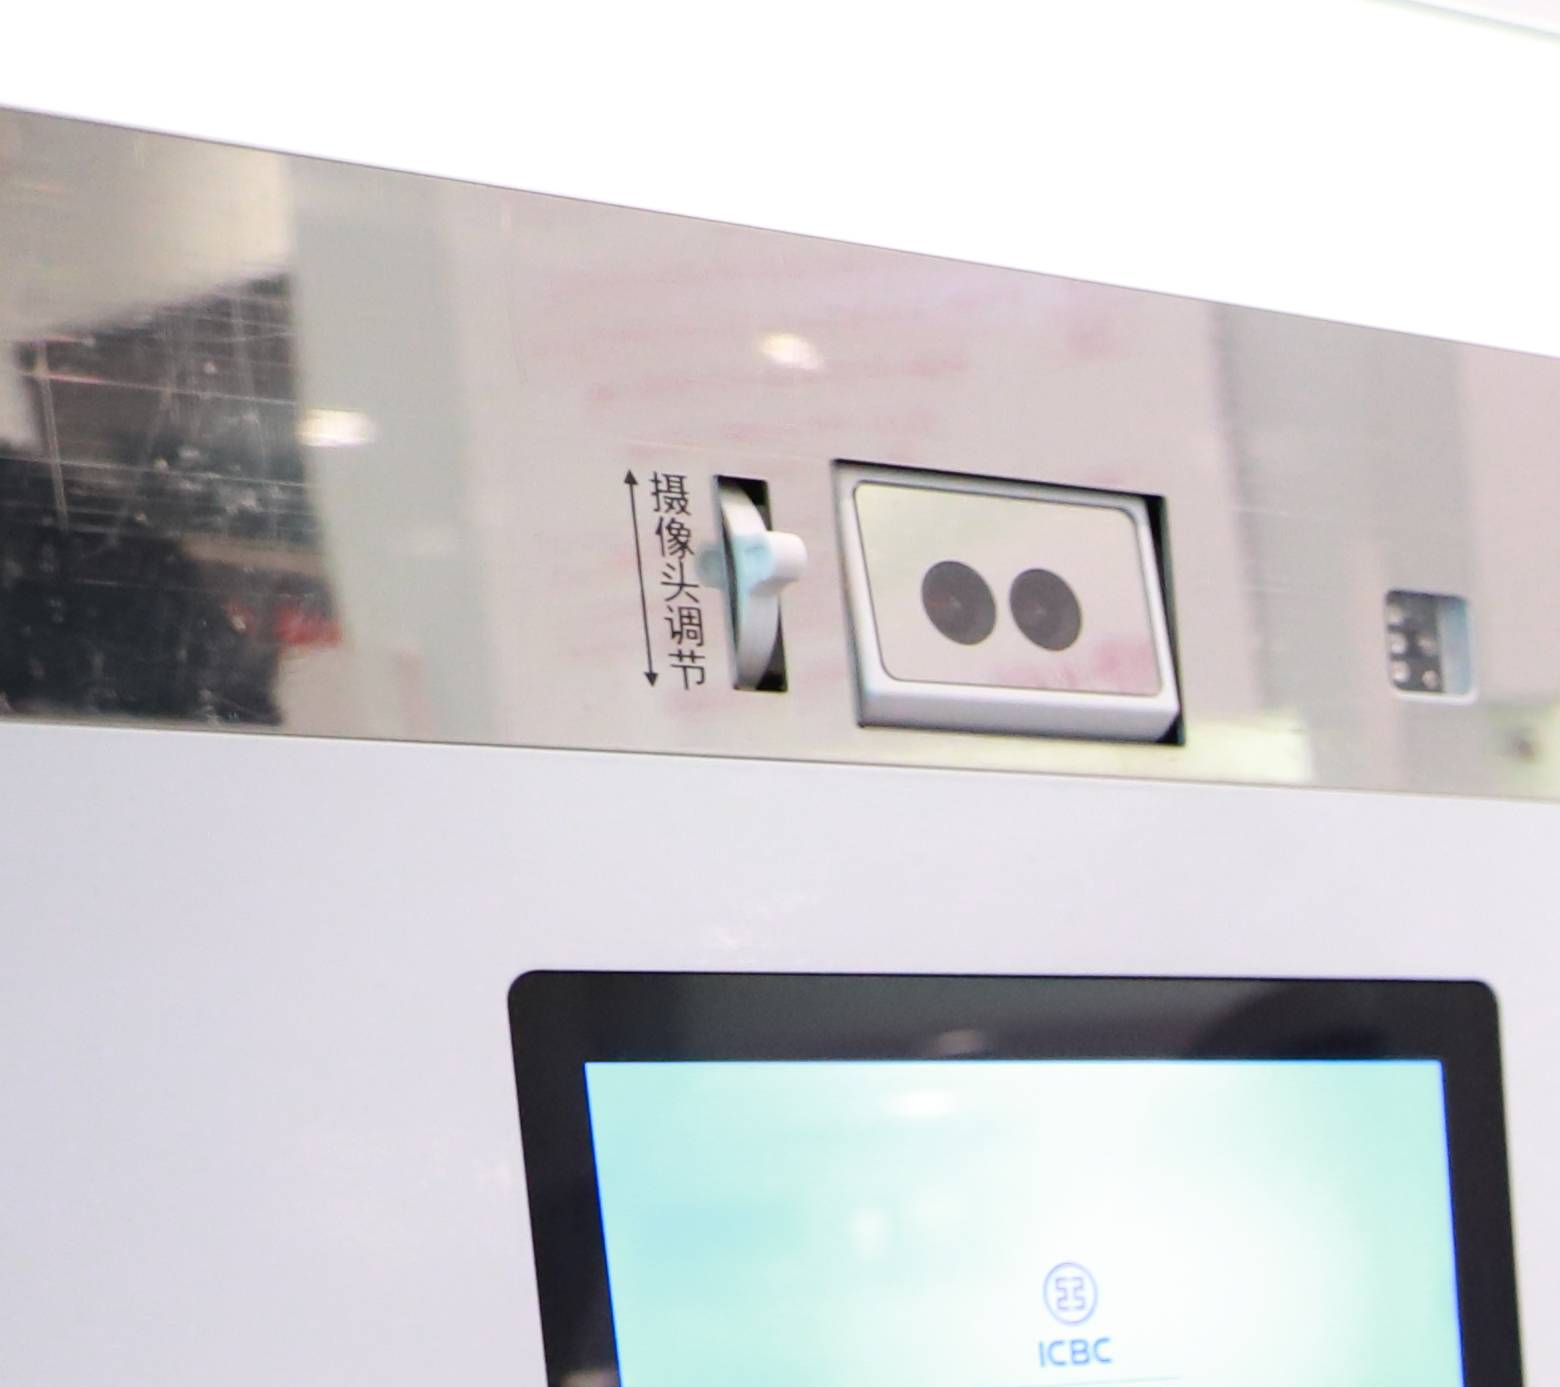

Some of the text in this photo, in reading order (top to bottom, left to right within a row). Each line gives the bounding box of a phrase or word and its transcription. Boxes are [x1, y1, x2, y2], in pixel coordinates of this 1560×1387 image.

[649, 470, 706, 691] 摄像头调节
[1038, 1337, 1113, 1368] ICBC
